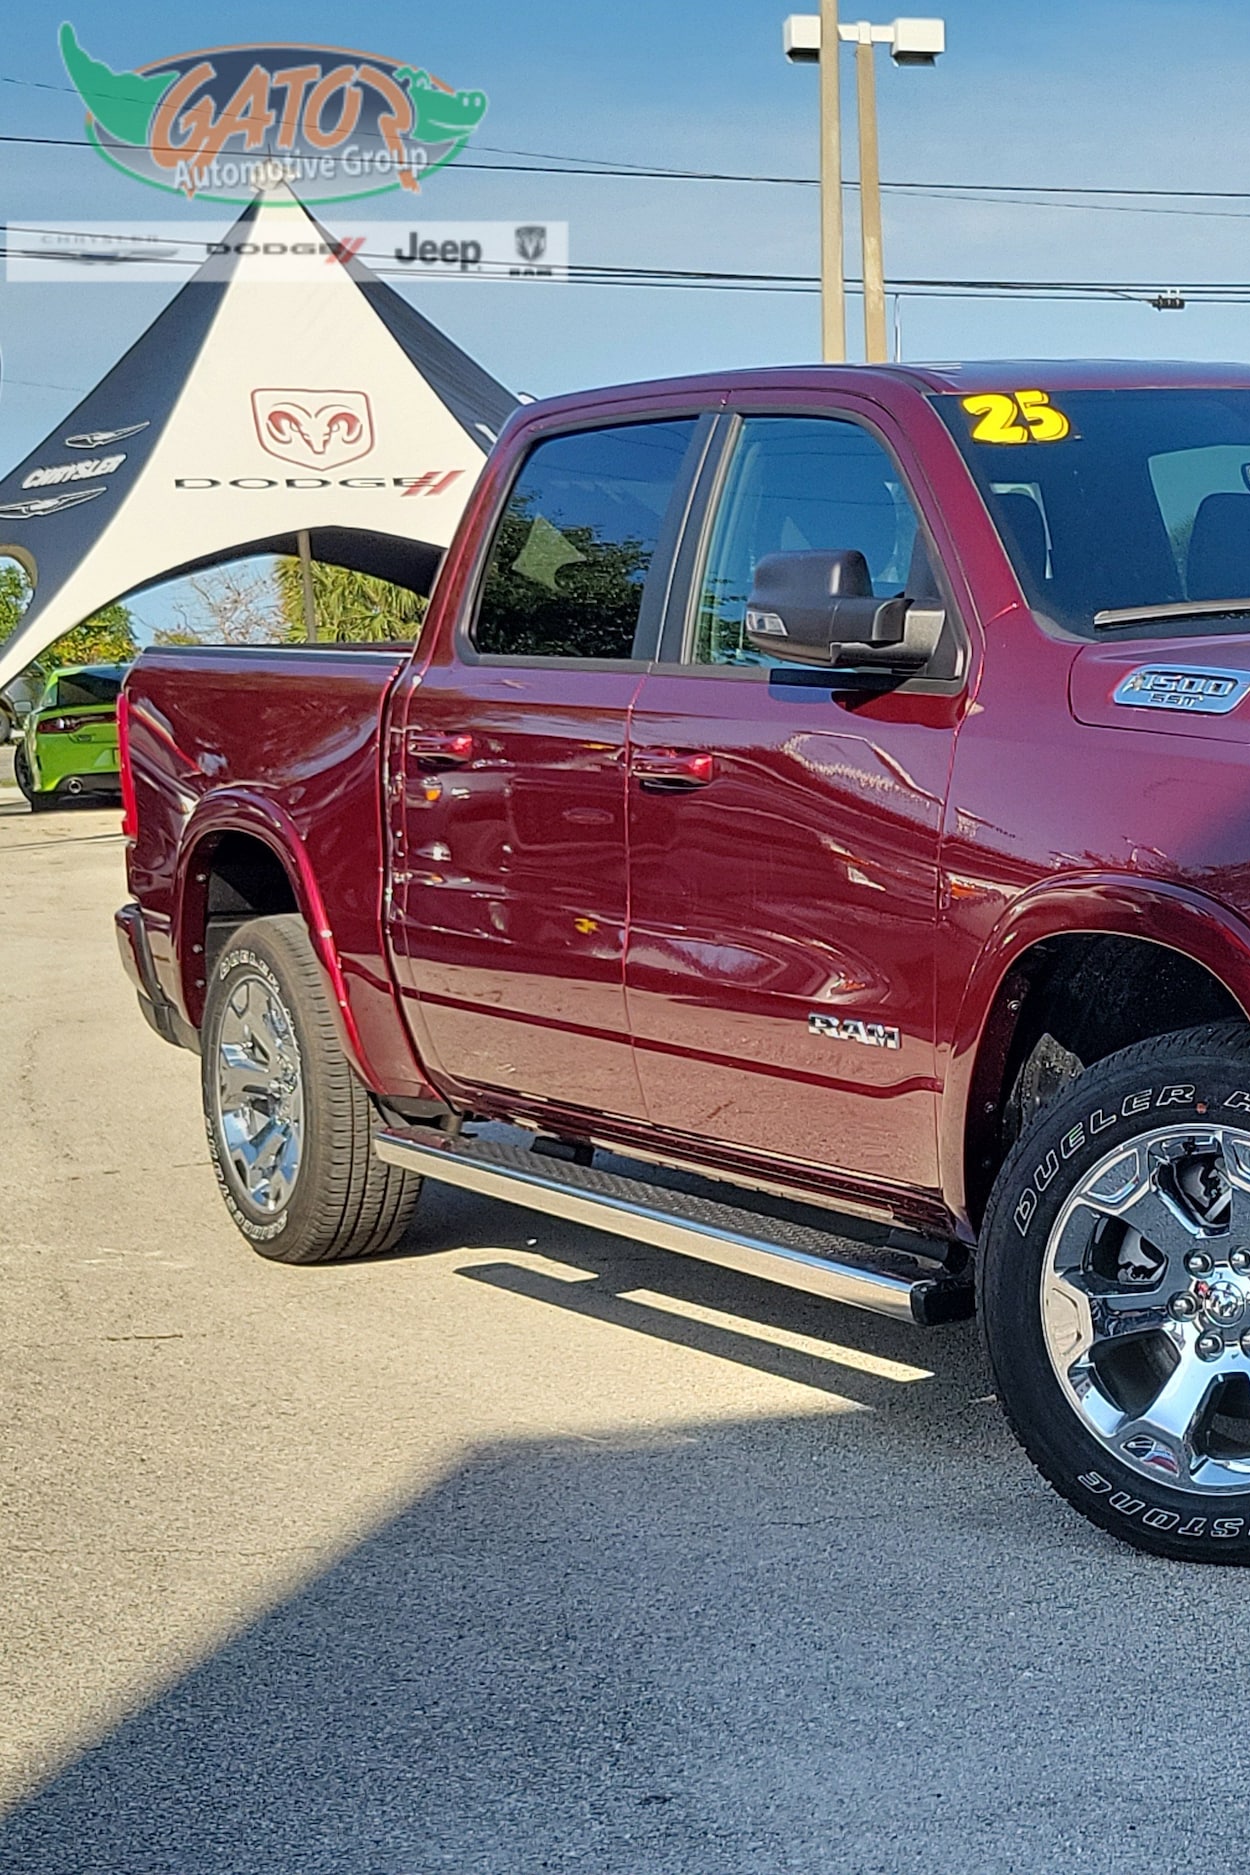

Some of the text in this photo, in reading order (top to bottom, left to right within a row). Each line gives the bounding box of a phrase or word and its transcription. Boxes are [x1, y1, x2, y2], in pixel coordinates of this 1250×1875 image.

[962, 389, 1071, 444] 25
[174, 477, 437, 490] DODGE
[808, 1012, 900, 1049] RAM
[1013, 1084, 1196, 1237] DUELER
